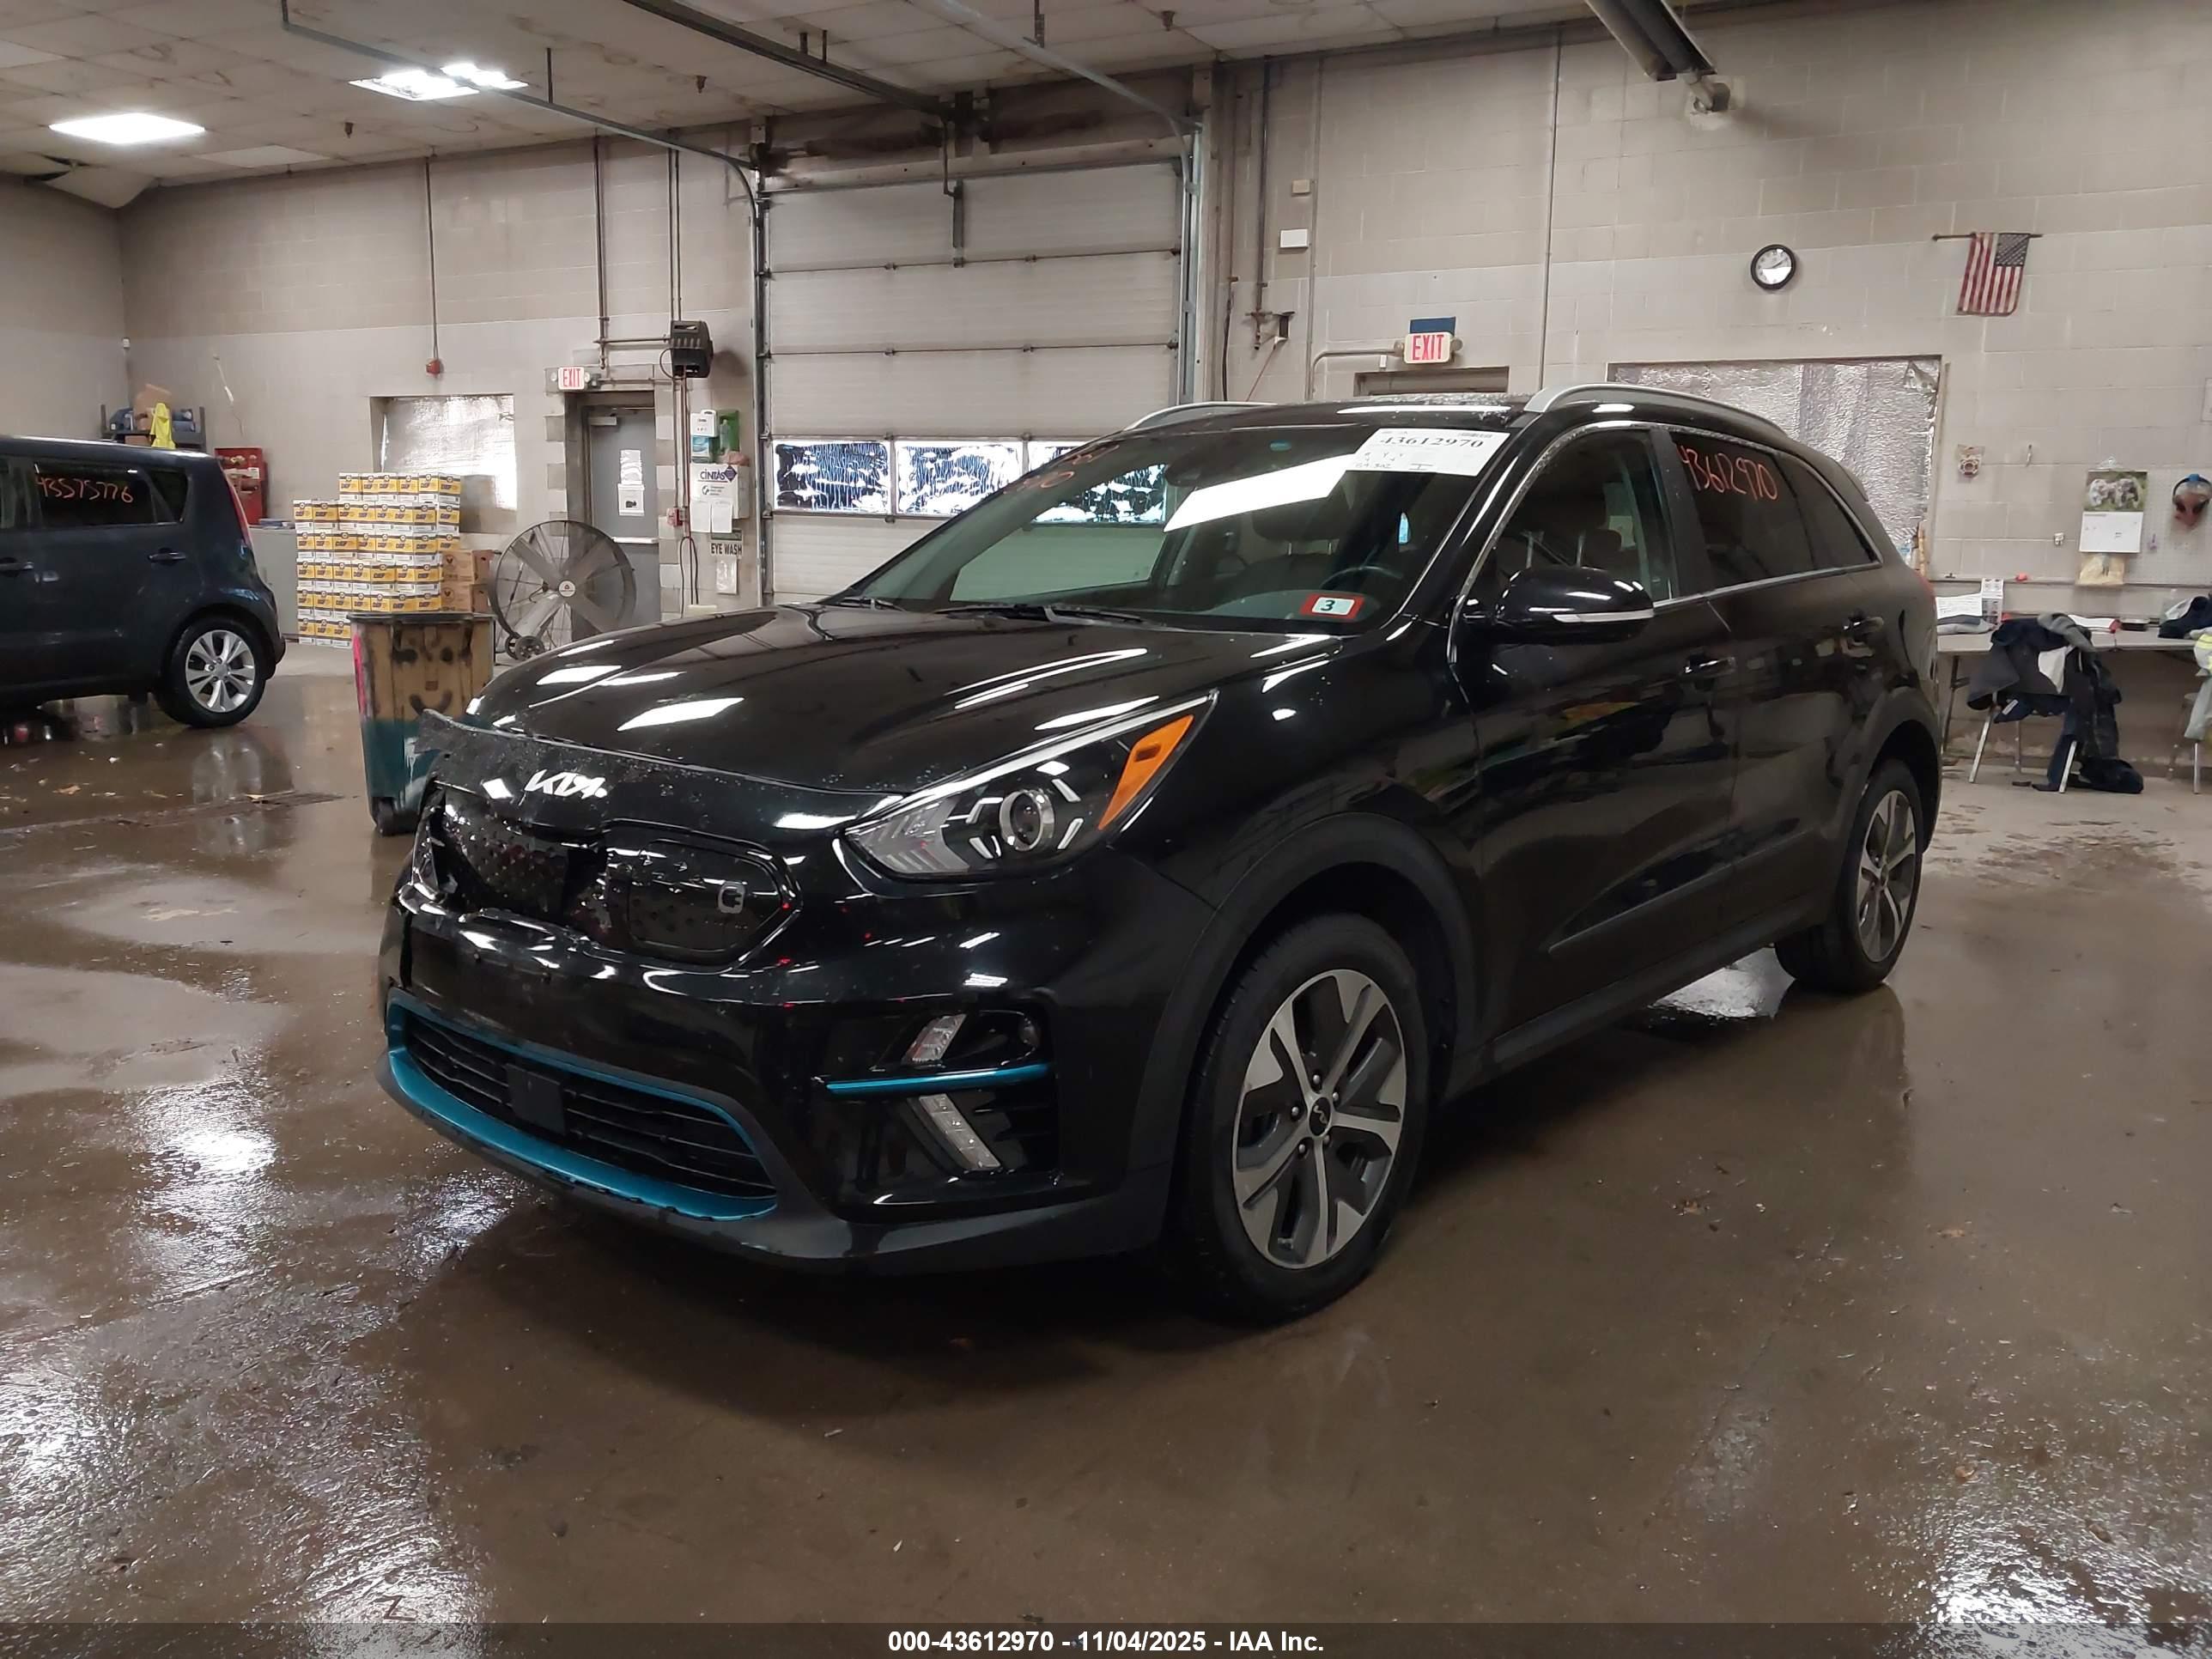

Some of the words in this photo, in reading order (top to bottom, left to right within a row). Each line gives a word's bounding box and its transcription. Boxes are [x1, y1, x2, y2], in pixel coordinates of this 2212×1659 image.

[554, 334, 586, 361] EXIT
[562, 368, 581, 387] EXIT
[1380, 436, 1485, 448] 43612970
[1676, 445, 1778, 501] 43612970
[711, 543, 723, 555] EYE
[724, 543, 743, 556] WASH
[1320, 599, 1336, 611] 3
[524, 769, 607, 800] KIA
